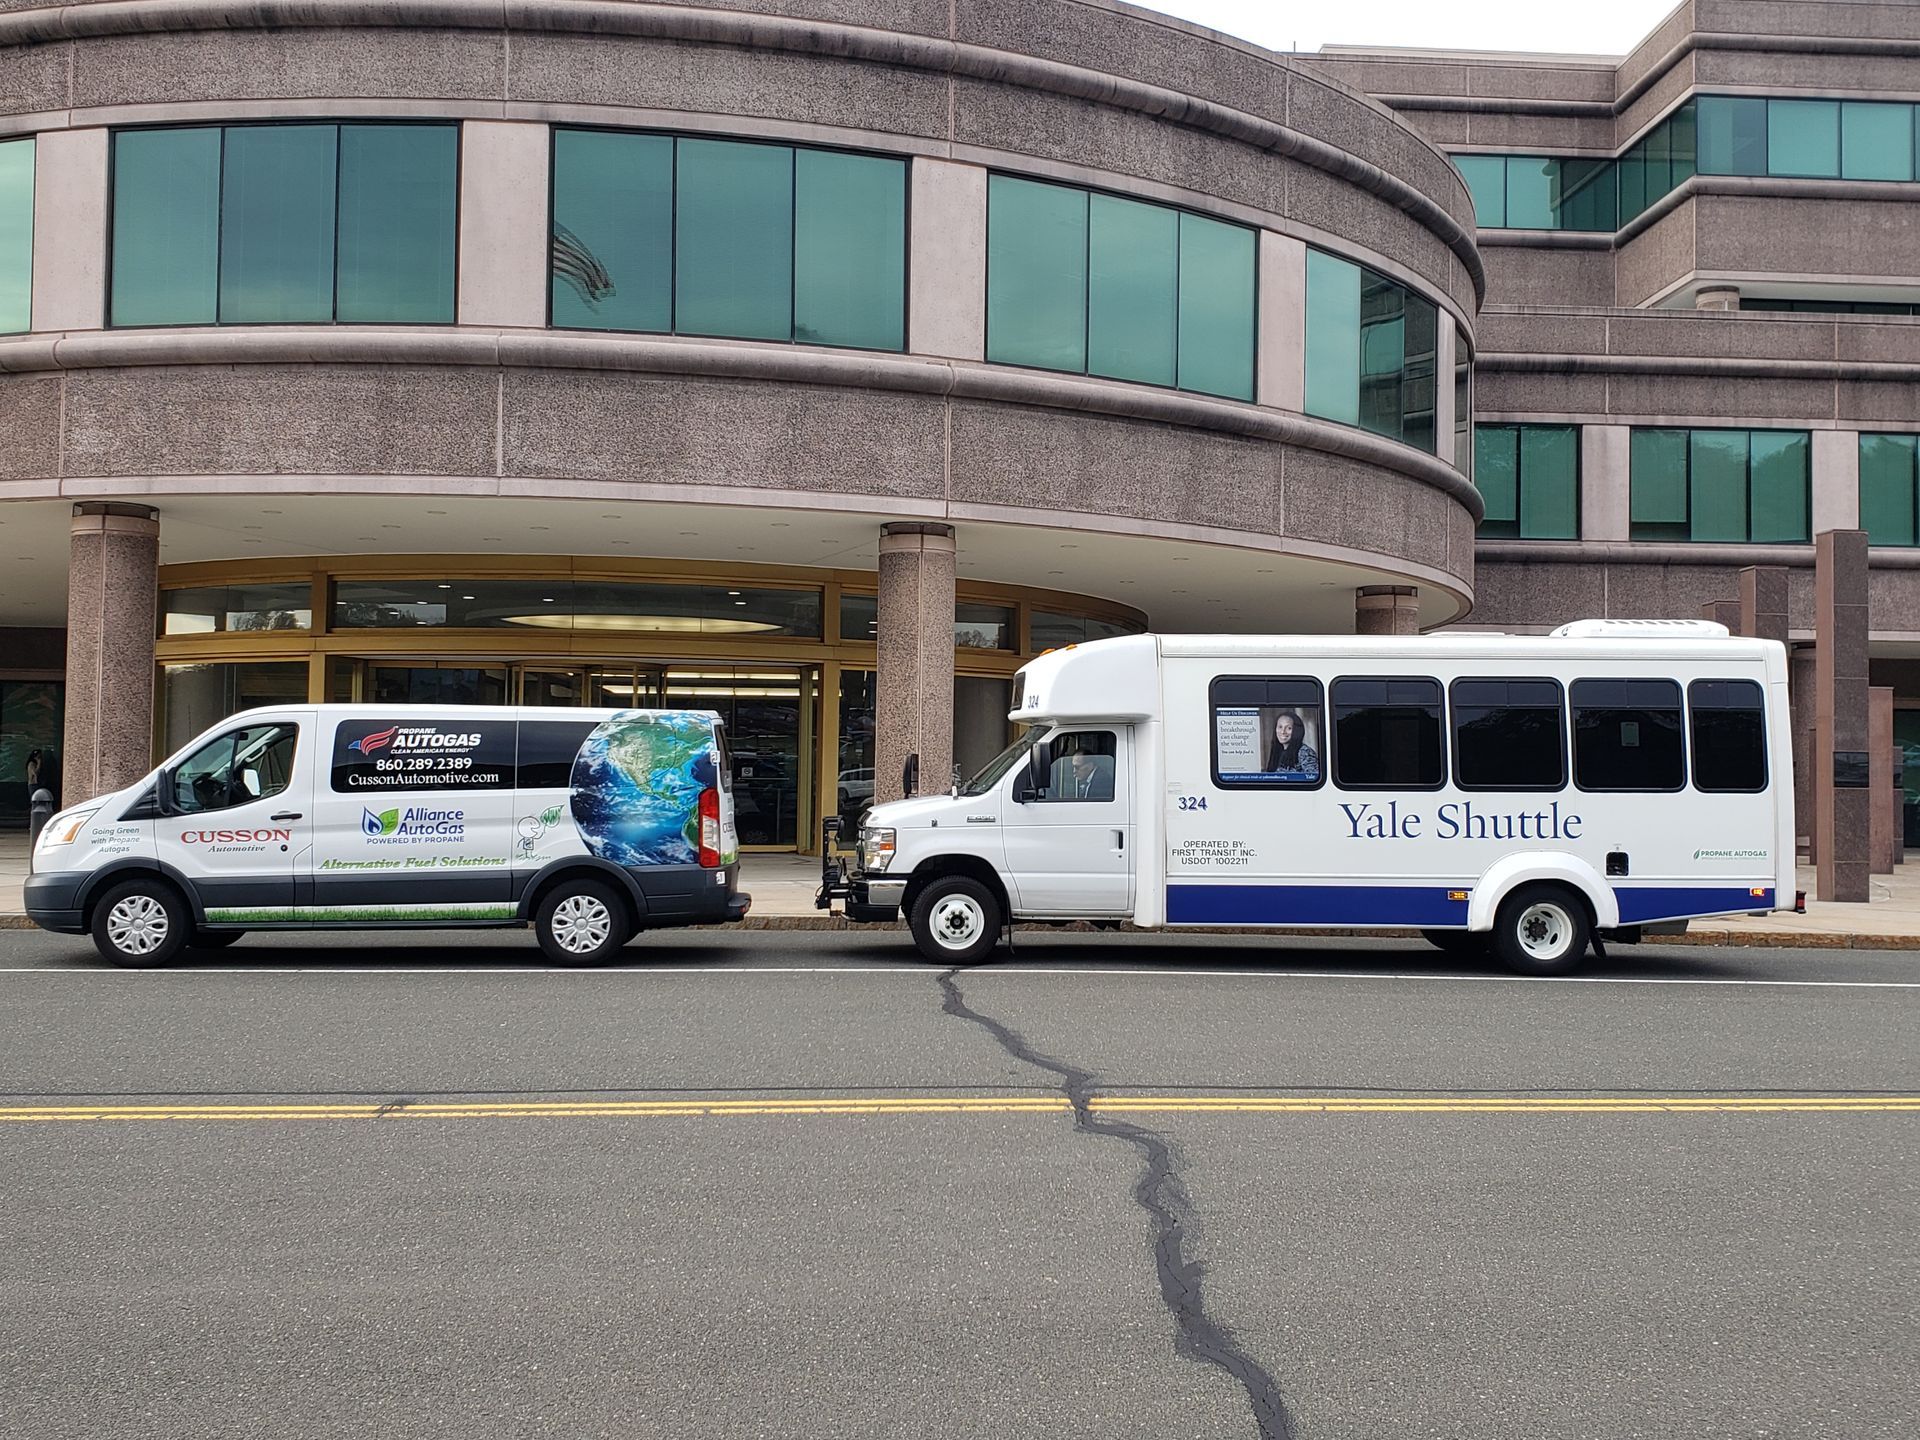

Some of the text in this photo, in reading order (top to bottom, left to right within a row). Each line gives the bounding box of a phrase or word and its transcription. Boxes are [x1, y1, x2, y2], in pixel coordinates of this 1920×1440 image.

[1028, 695, 1039, 709] 324
[398, 727, 437, 735] PROPANE
[1220, 726, 1257, 734] breakthrough
[392, 733, 482, 748] AUTOGAS
[376, 757, 473, 771] 860.289.2389
[348, 771, 499, 786] CussonAutomotive.com
[1178, 796, 1208, 811] 324
[403, 807, 464, 822] Alliance
[1337, 800, 1583, 840] Yale Shuttle
[92, 827, 115, 836] Going
[397, 821, 465, 836] AutoGas
[91, 836, 140, 845] with Propane
[180, 829, 292, 844] CUSSON
[367, 837, 409, 845] POWERED
[425, 835, 465, 844] PROPANE
[98, 846, 131, 854] Autogas
[208, 844, 266, 853] Automotive
[1183, 840, 1247, 848] OPERATED BY:
[1171, 849, 1258, 857] FIRST TRANSIT INC.
[318, 855, 508, 870] Alternative Fuel Solutions
[1181, 857, 1248, 865] USDOT 1002211
